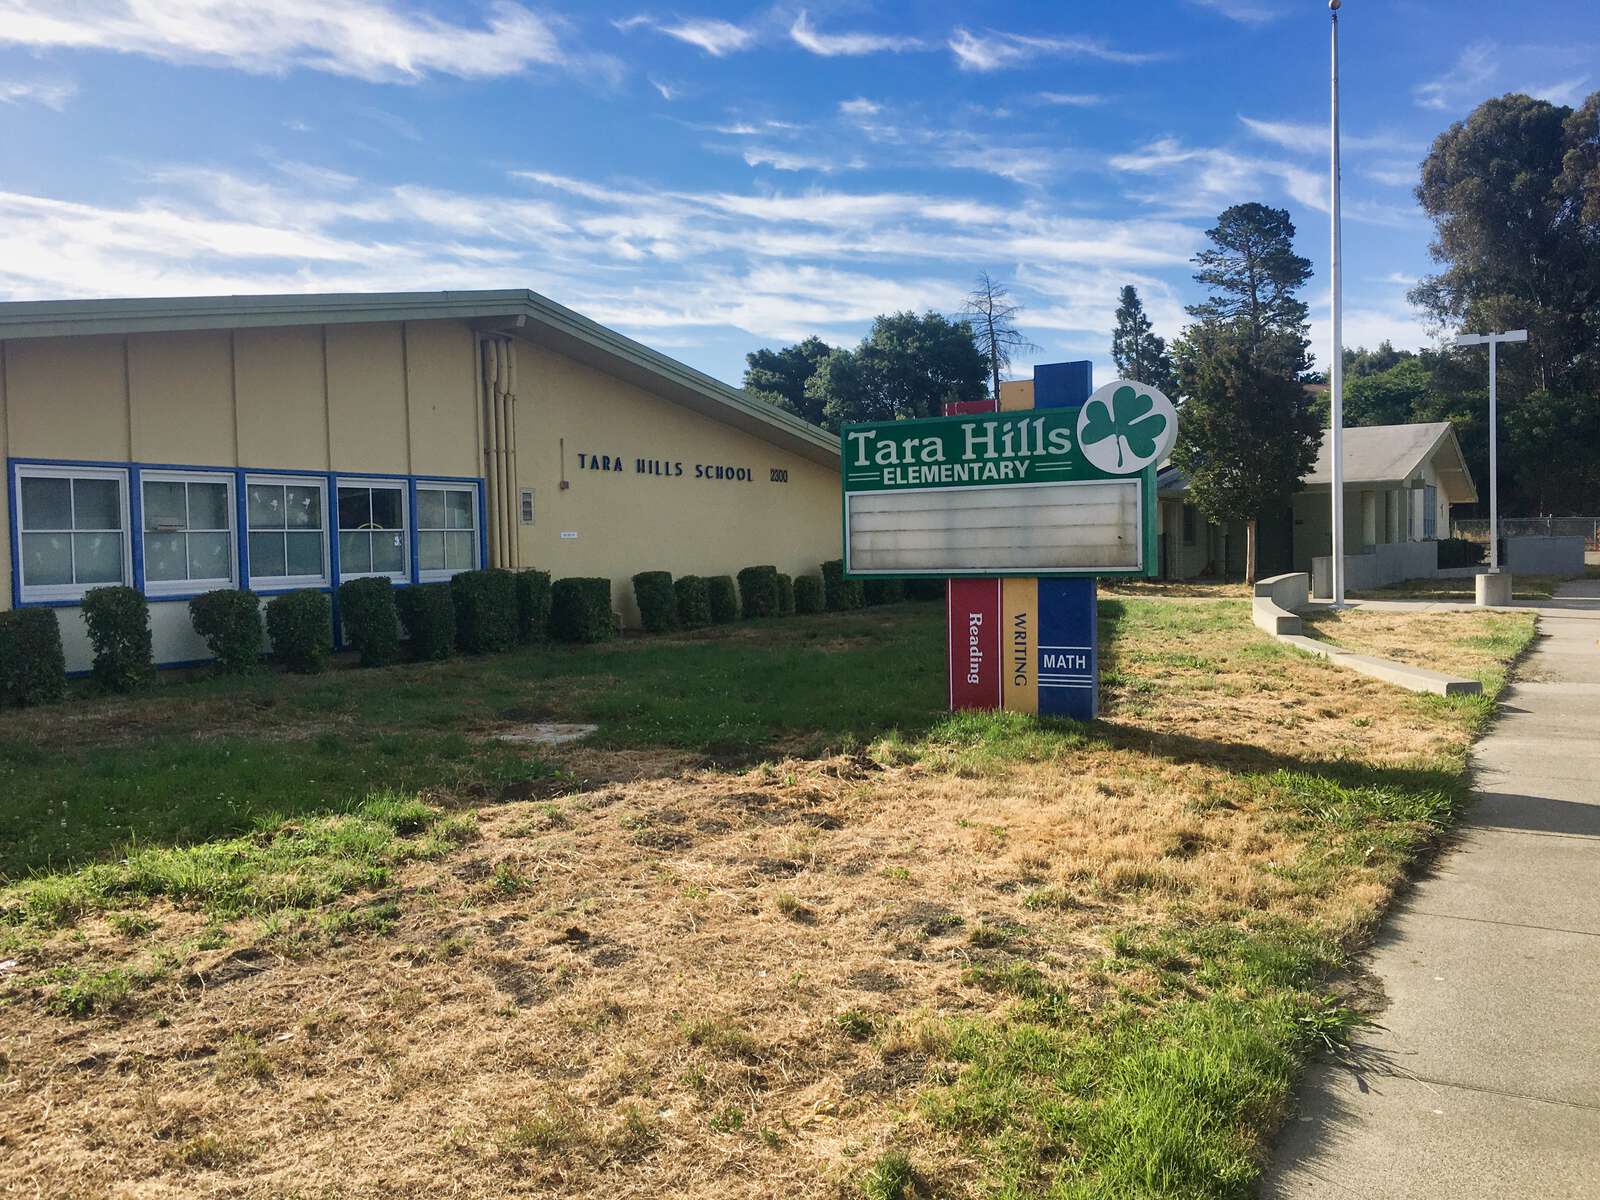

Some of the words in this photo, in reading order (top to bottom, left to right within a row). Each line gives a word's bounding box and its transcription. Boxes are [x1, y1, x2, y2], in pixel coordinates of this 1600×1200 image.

[848, 430, 946, 466] Tara
[961, 416, 1072, 460] Hills
[577, 453, 623, 472] TARA
[636, 458, 683, 477] HILLS
[695, 464, 753, 482] SCHOOL
[769, 468, 788, 483] 2300
[883, 460, 1030, 485] ELEMENTARY
[967, 612, 984, 684] Reading
[1014, 612, 1028, 687] WRITING
[1043, 654, 1086, 669] MATH
